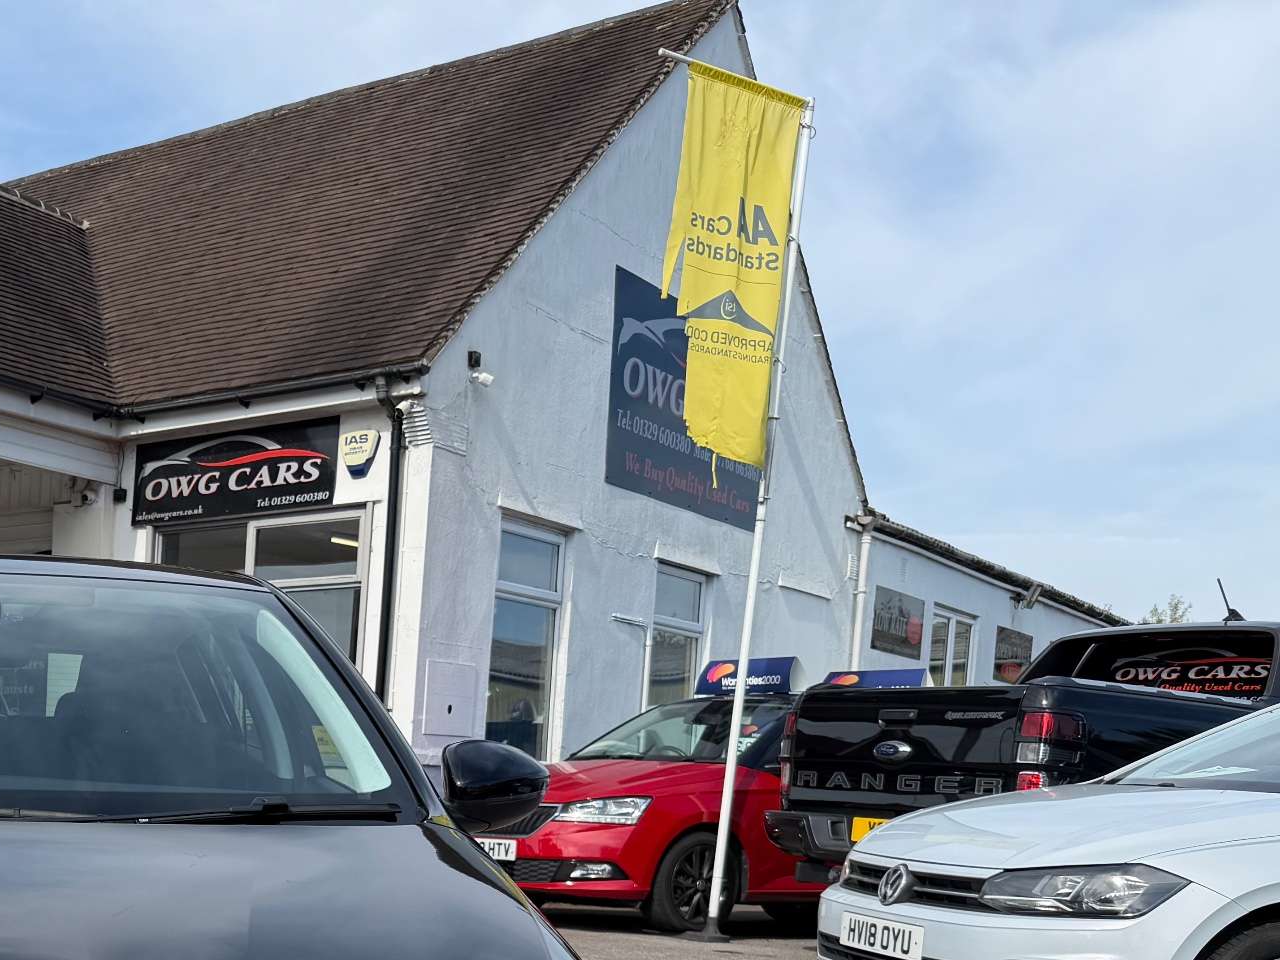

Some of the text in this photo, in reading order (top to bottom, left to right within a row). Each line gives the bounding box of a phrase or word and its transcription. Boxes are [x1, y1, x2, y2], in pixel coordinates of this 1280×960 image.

[623, 356, 686, 417] OWG
[344, 433, 369, 446] IAS
[633, 416, 658, 441] 01329
[659, 426, 691, 454] 600380
[145, 458, 322, 501] OWG CARS
[625, 451, 640, 475] We
[644, 458, 665, 493] Buy
[665, 466, 704, 504] Quality
[729, 488, 751, 513] Cars
[270, 495, 295, 506] 01329
[295, 491, 329, 503] 600380
[721, 675, 781, 687] Warnties2000
[1115, 664, 1270, 681] OWG CARS
[1205, 682, 1231, 691] Used
[1234, 682, 1262, 691] Cars
[796, 770, 1002, 795] RANGER
[487, 841, 510, 857] HTV
[847, 917, 912, 955] HV18 OYU
